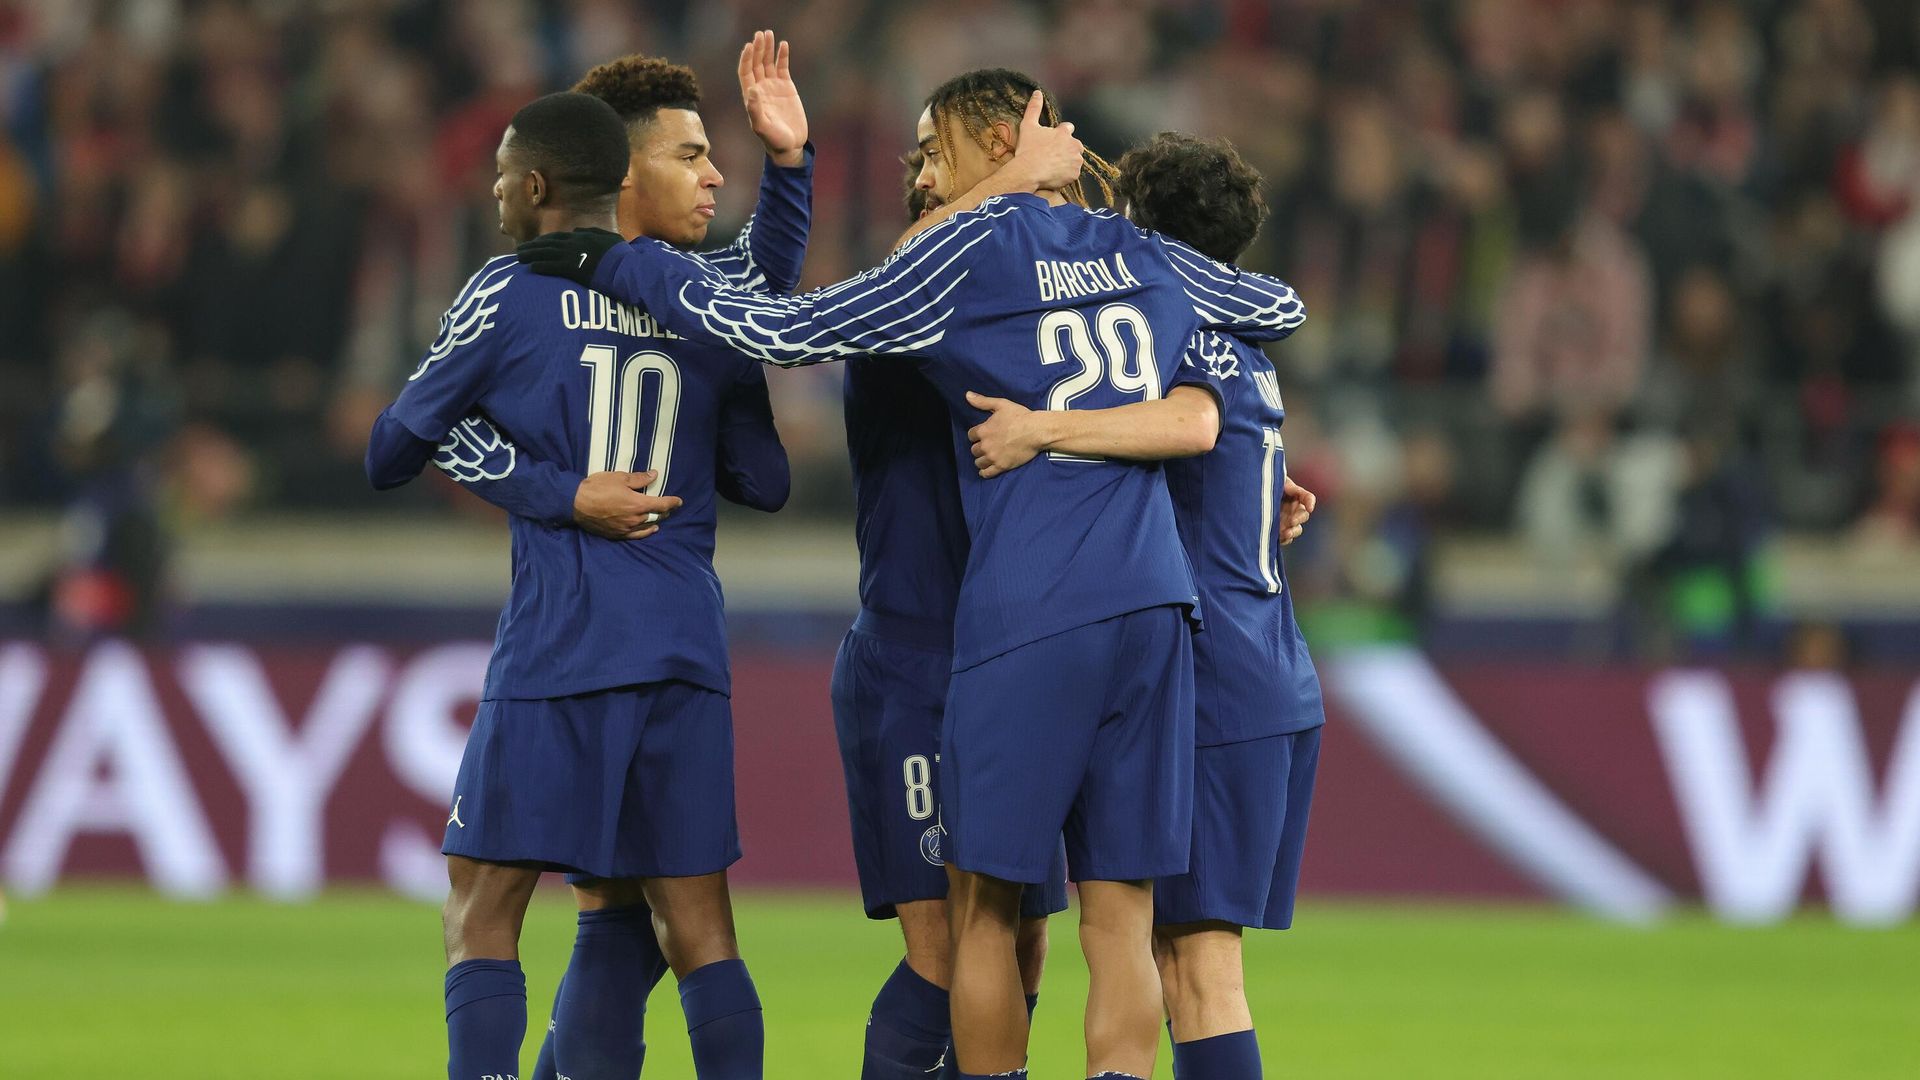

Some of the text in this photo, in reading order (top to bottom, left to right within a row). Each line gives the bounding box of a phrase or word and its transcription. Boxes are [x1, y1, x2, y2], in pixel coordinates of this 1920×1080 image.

[1035, 252, 1141, 302] BARCOLA
[580, 343, 682, 523] 10
[1037, 303, 1162, 463] 29
[903, 753, 941, 820] 8
